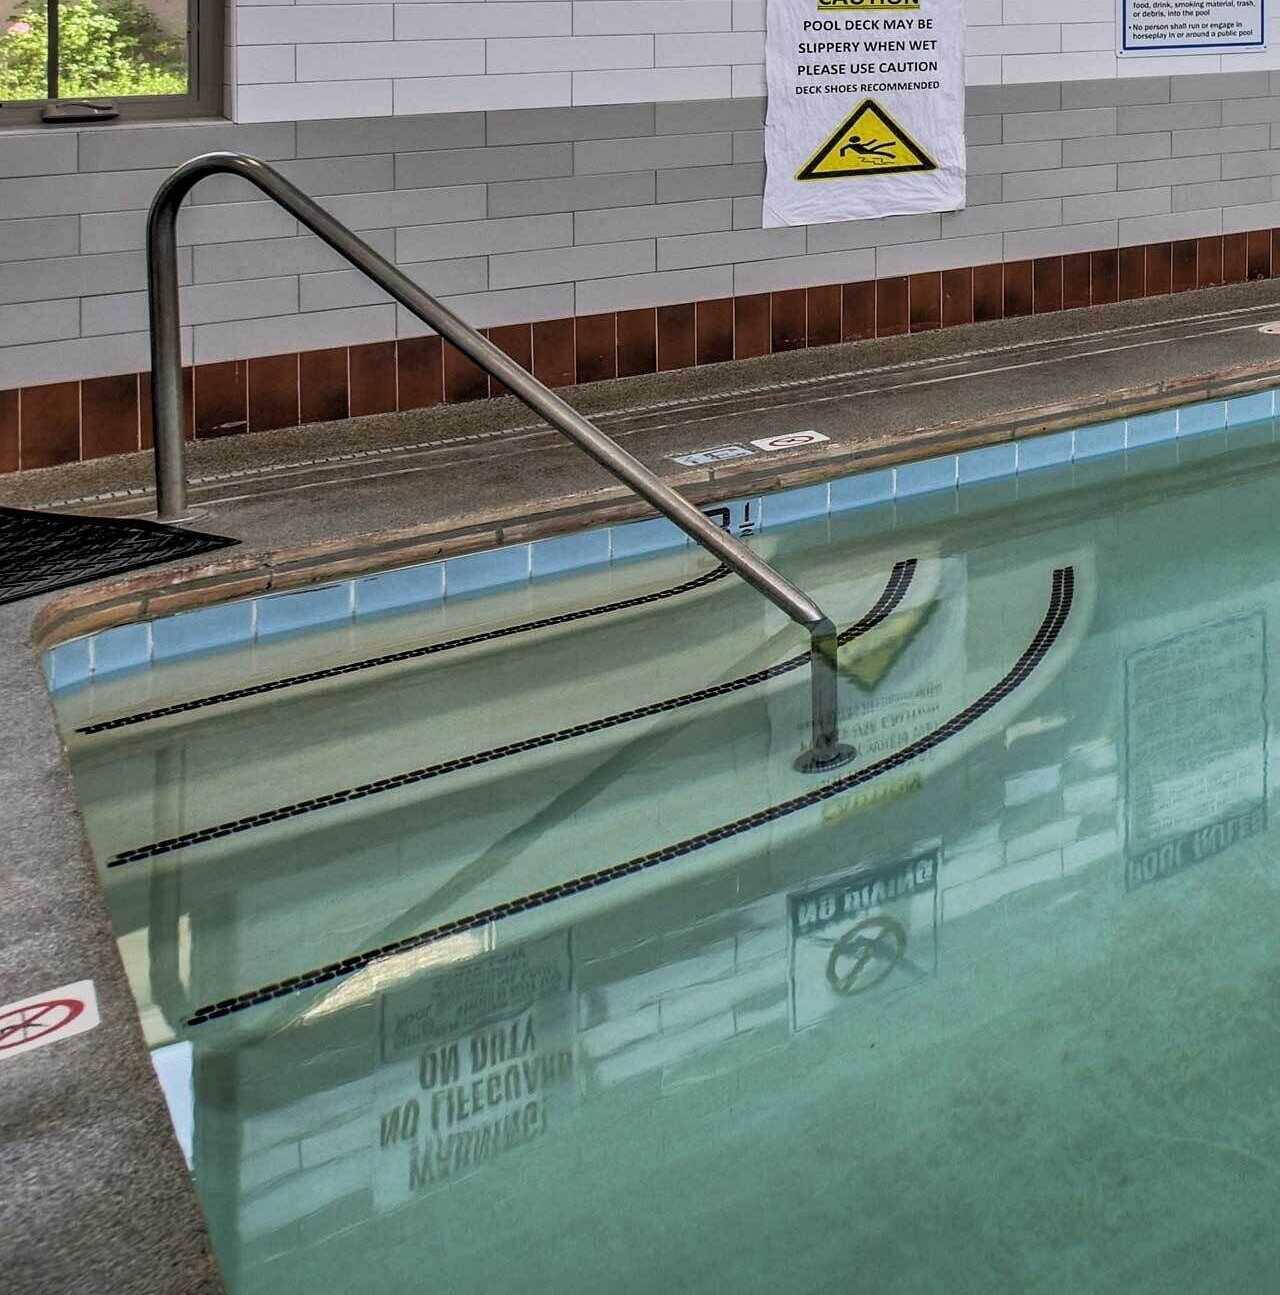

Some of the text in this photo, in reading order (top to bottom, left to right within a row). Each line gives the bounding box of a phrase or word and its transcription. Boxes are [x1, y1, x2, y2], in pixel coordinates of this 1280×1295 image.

[803, 19, 933, 31] POOL DECK MAY BE
[798, 40, 938, 54] SLIPPERY WHEN WET
[797, 61, 938, 76] PLEASE USE CAUTION
[795, 81, 940, 95] DECK SHOES RECOMMENDED
